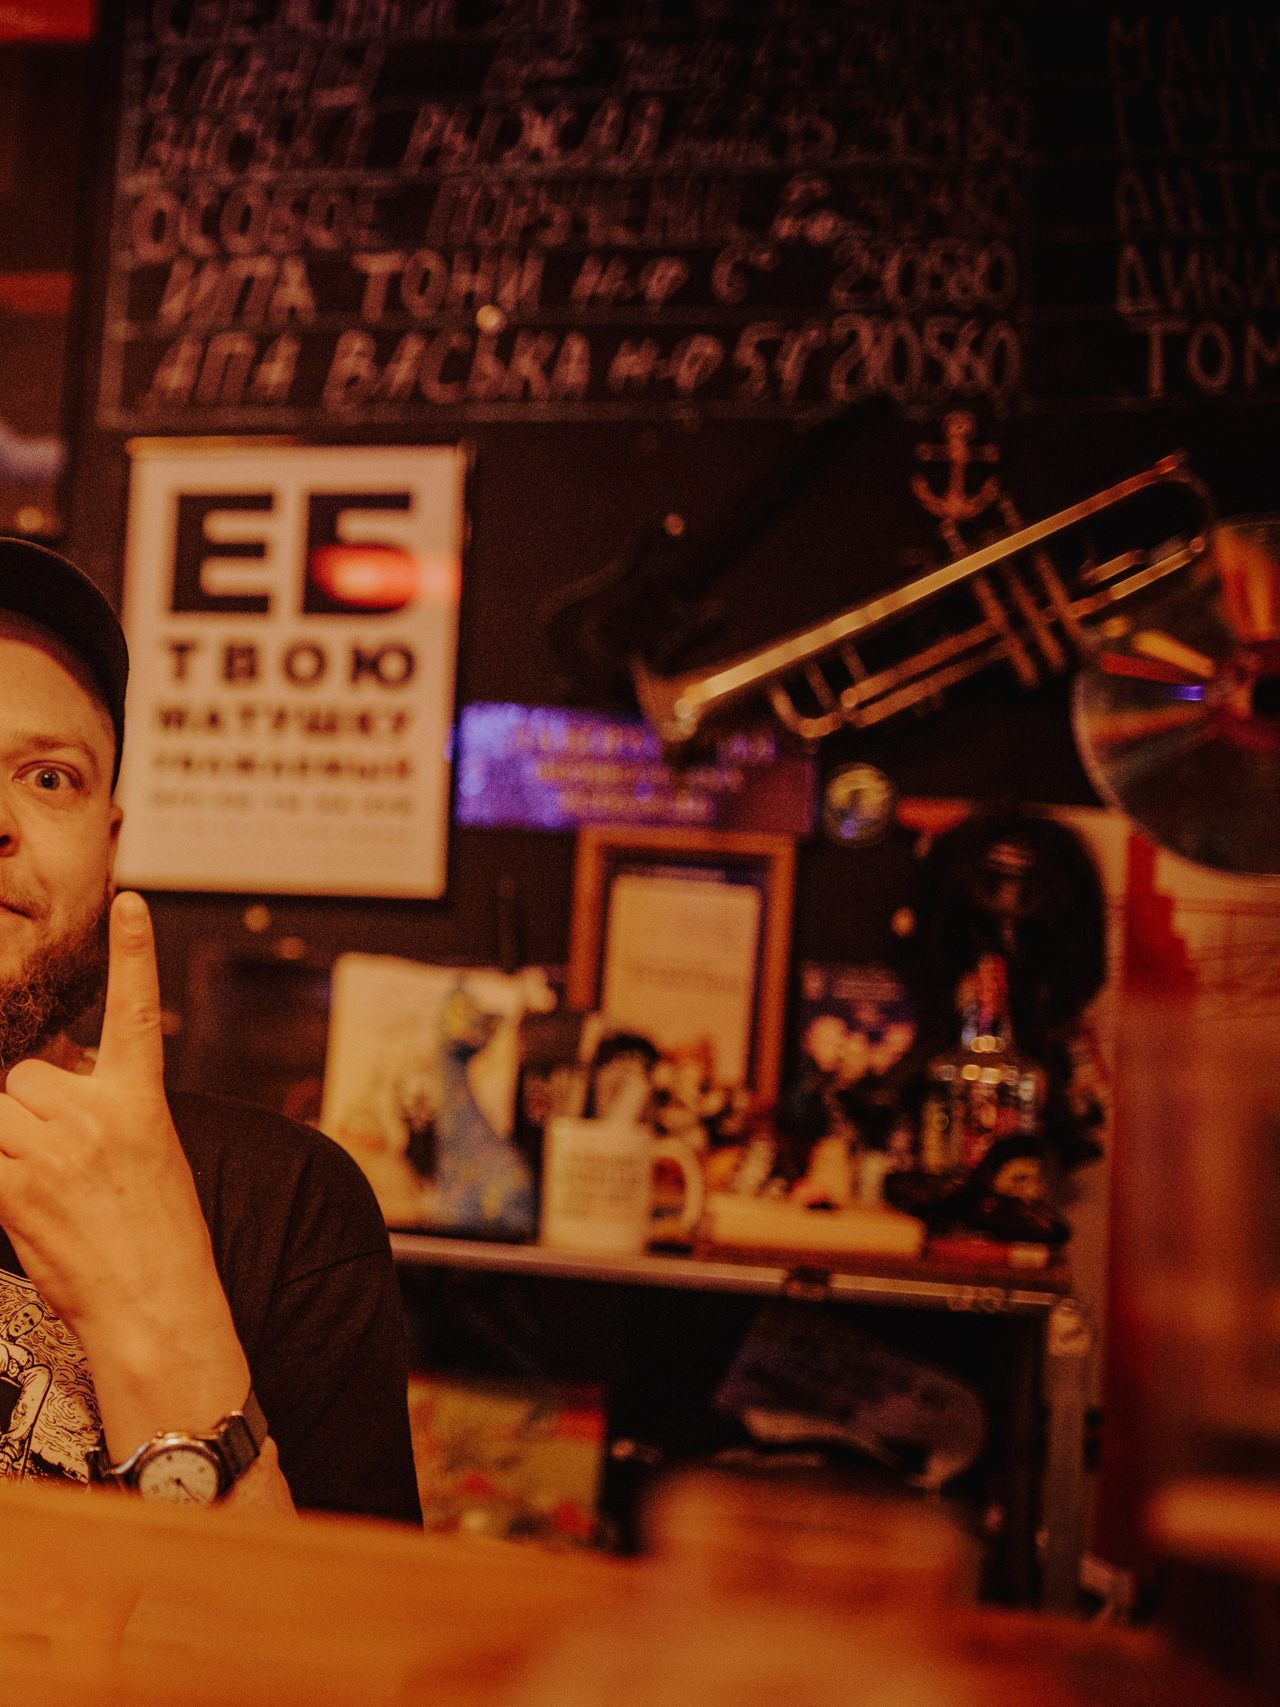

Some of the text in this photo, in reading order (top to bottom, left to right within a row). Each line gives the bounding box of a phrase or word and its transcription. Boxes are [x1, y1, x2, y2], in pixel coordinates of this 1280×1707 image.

[128, 188, 386, 262] ОСОБОЕ
[158, 252, 318, 326] ИПА
[350, 248, 548, 324] ТОНИ
[144, 330, 302, 402] АПА
[320, 328, 594, 408] ВАСЬКА
[1124, 312, 1280, 398] ТОМ
[172, 494, 412, 614] ЕБ
[166, 640, 416, 688] ТВОЮ
